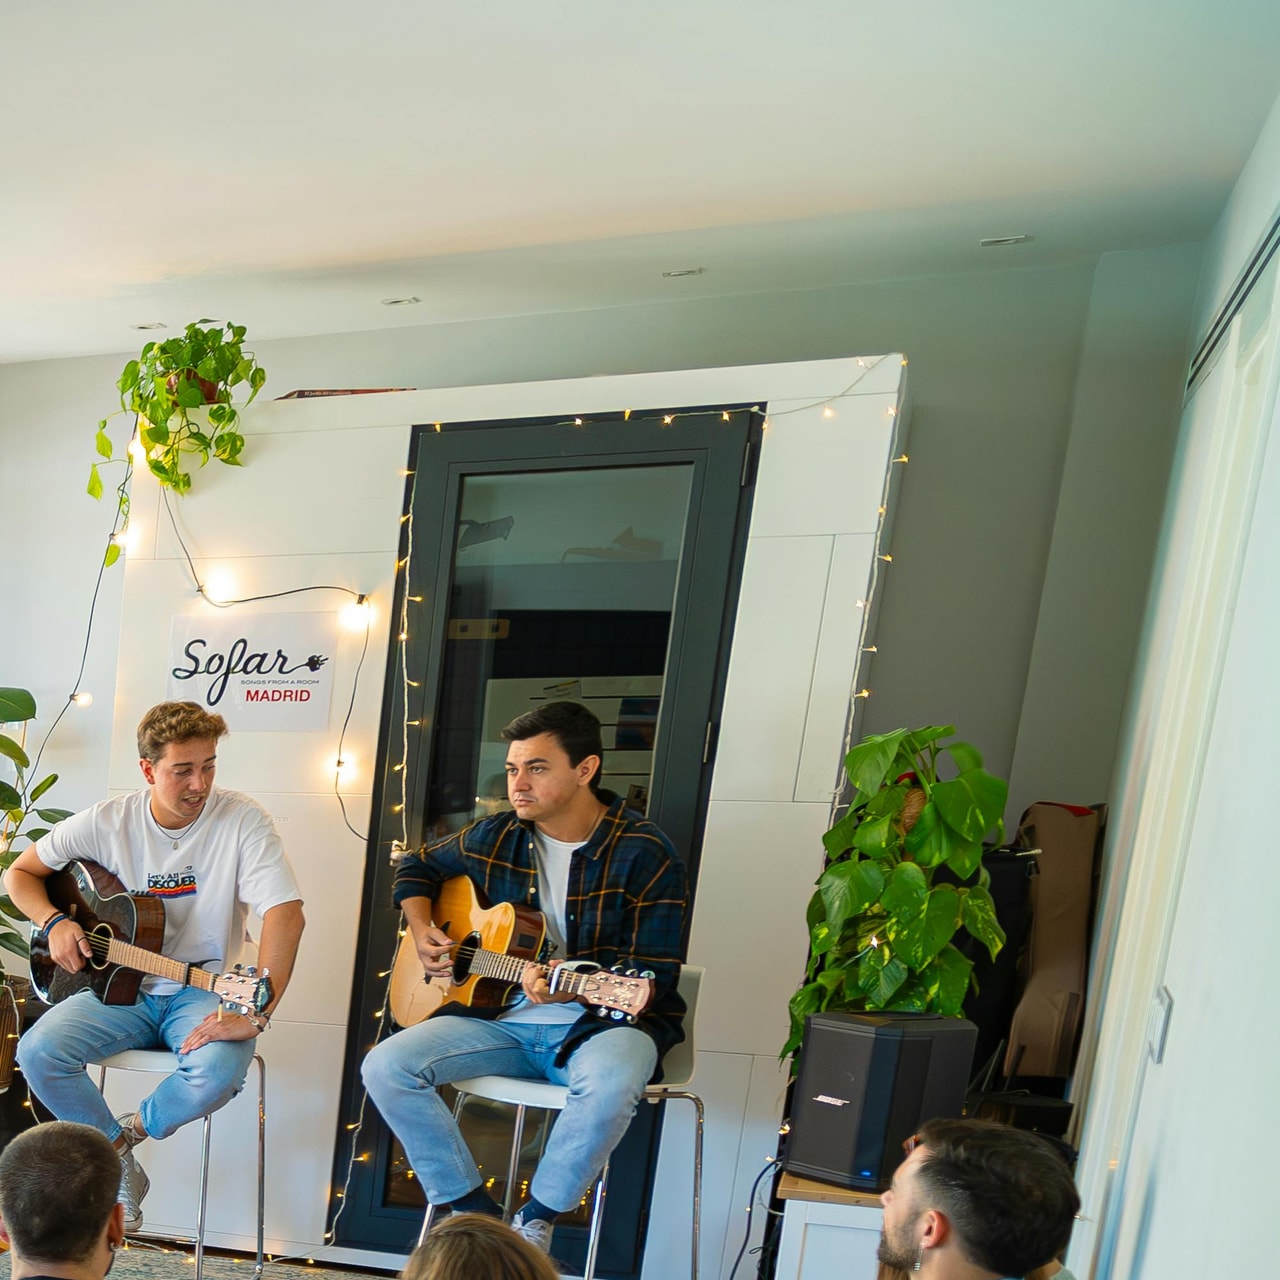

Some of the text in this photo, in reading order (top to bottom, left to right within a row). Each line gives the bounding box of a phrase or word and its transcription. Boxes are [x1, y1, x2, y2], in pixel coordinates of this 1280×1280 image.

[172, 638, 289, 706] Sofar
[246, 689, 311, 702] MADRID
[147, 872, 165, 880] Let's
